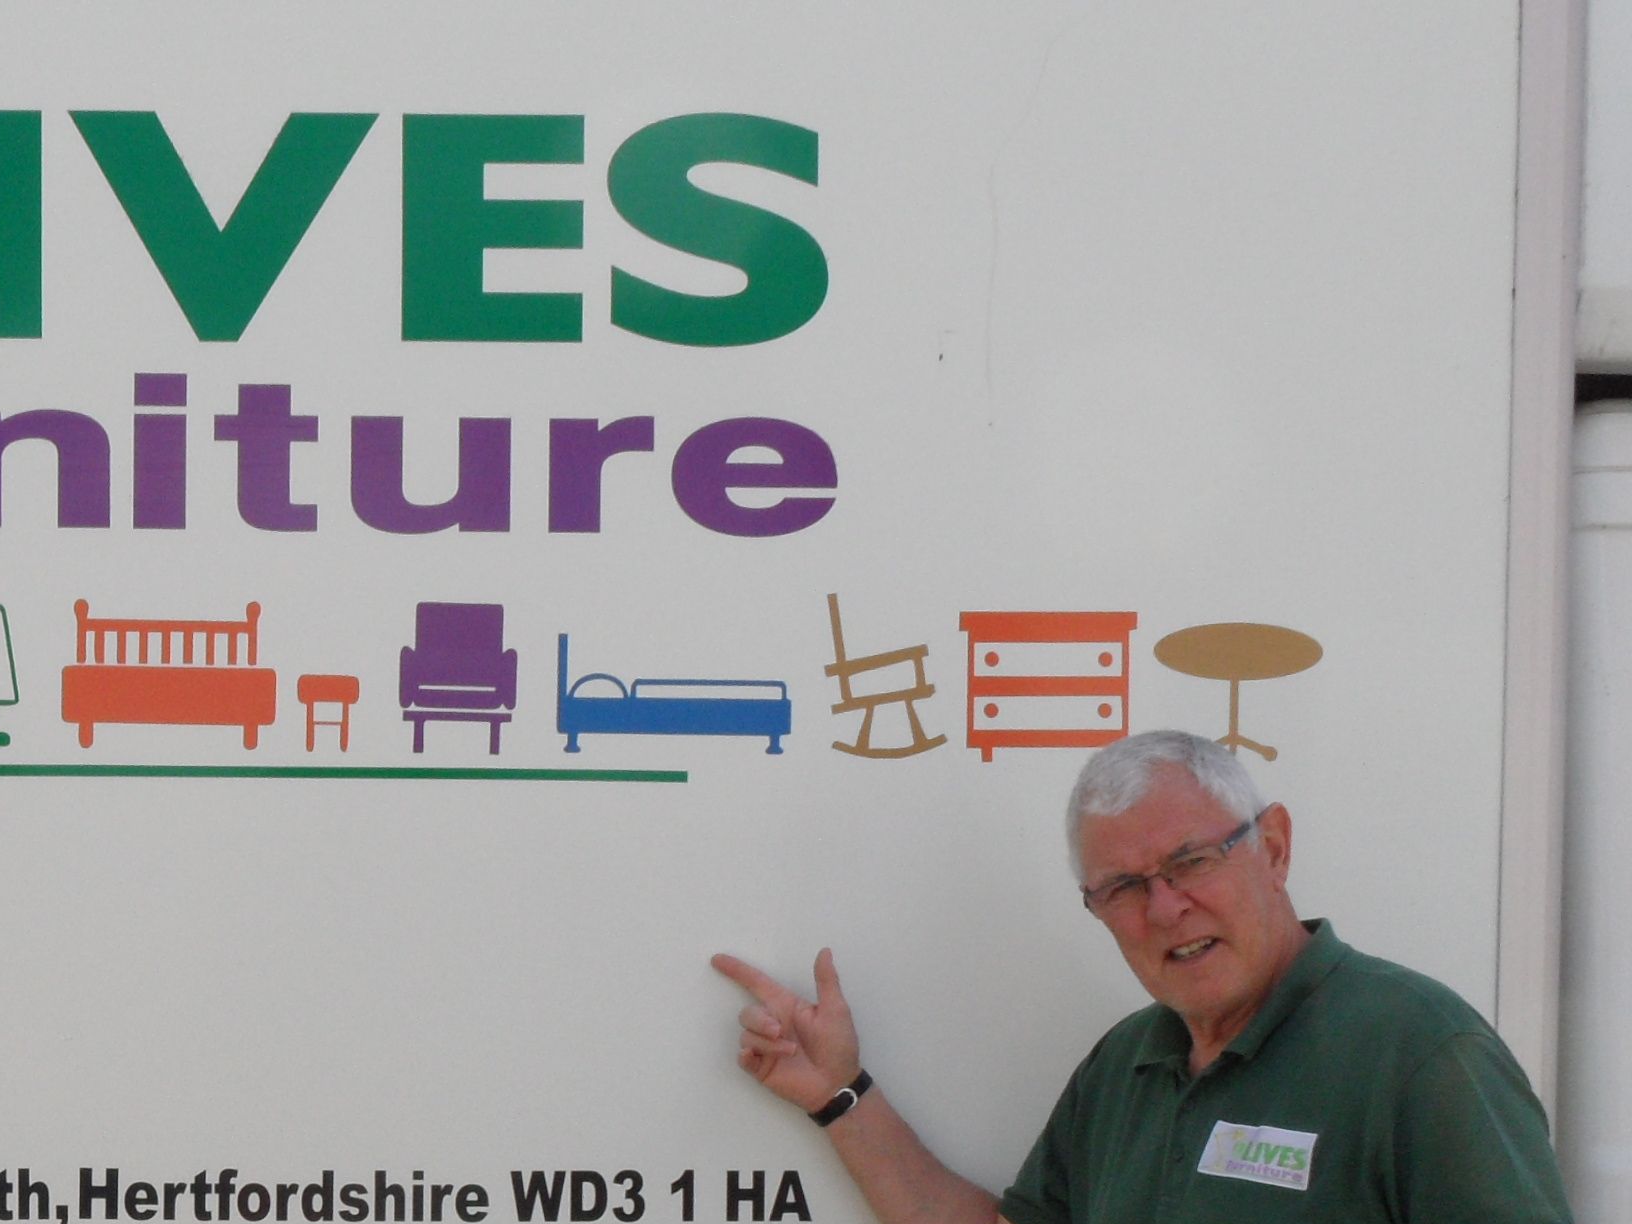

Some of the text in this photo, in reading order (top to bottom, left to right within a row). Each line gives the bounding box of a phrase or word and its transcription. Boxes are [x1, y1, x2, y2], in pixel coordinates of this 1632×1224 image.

[510, 1170, 646, 1223] WD3
[670, 1169, 695, 1222] 1
[725, 1169, 813, 1222] HA
